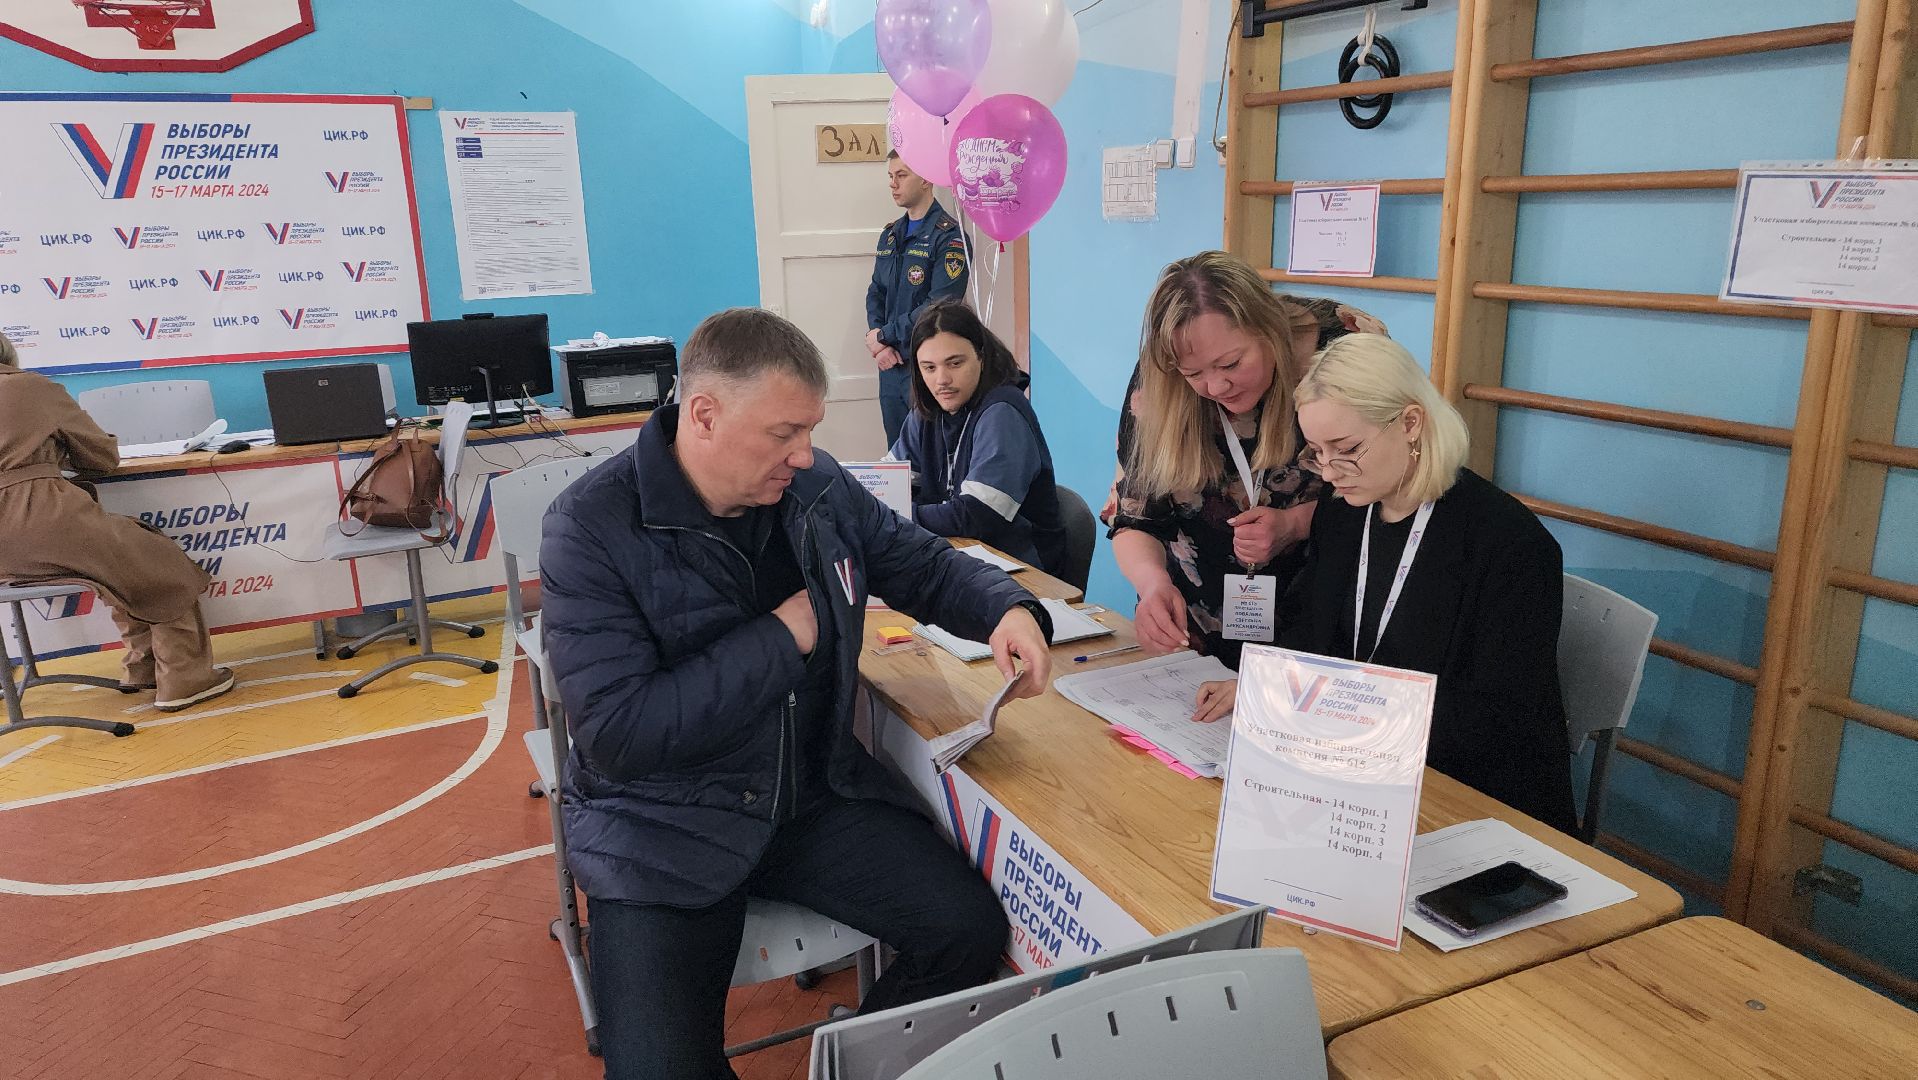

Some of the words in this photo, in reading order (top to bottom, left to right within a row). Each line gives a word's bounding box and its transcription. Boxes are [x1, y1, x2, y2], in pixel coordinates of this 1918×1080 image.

[167, 123, 251, 139] ВЫБОРЫ
[323, 130, 368, 142] ЦИК.РФ
[821, 126, 880, 157] ЗАЛ
[161, 143, 279, 161] ПРЕЗИДЕНТА
[155, 164, 231, 180] РОССИИ
[190, 184, 234, 198] МАРТА
[238, 184, 269, 197] 2024
[197, 228, 245, 242] ЦИК.РФ
[342, 225, 386, 238] ЦИК.РФ
[1781, 233, 1837, 244] Строительная
[40, 234, 93, 247] ЦИК.РФ
[129, 277, 179, 291] ЦИК.РФ
[279, 271, 324, 283] ЦИК.РФ
[213, 315, 260, 328] ЦИК.РФ
[355, 308, 398, 321] ЦИК.РФ
[59, 325, 111, 339] ЦИК.РФ
[140, 502, 249, 529] ВЫБОРЫ
[170, 522, 286, 552] ЗИДЕНТА
[200, 581, 227, 599] РТА
[232, 575, 273, 596] 2024
[1332, 678, 1376, 692] ВЫБОРЫ
[1319, 698, 1359, 712] РОССИИ
[1325, 688, 1387, 706] ПРЕЗИДЕНТА
[1334, 711, 1357, 722] МАРТА
[1249, 722, 1311, 743] Участковая
[1347, 756, 1366, 769] 615
[1244, 778, 1322, 804] Строительная
[1332, 798, 1345, 809] 14
[1348, 803, 1380, 818] корп.
[1383, 809, 1389, 820] 1
[1331, 812, 1343, 823] 14
[1345, 817, 1376, 831] корп.
[1379, 823, 1387, 833] 2
[1329, 825, 1341, 836] 14
[1343, 830, 1375, 845] корп.
[1377, 837, 1385, 847] 3
[1327, 839, 1339, 850] 14
[1342, 844, 1373, 859] корп.
[1376, 851, 1383, 861] 4
[1009, 830, 1083, 912] ВЫБОРЫ
[1004, 856, 1107, 956] ПРЕЗИДЕНТ
[1286, 893, 1316, 907] ЦИК.РФ
[1000, 883, 1064, 958] РОССИИ
[1026, 938, 1055, 970] МАР
